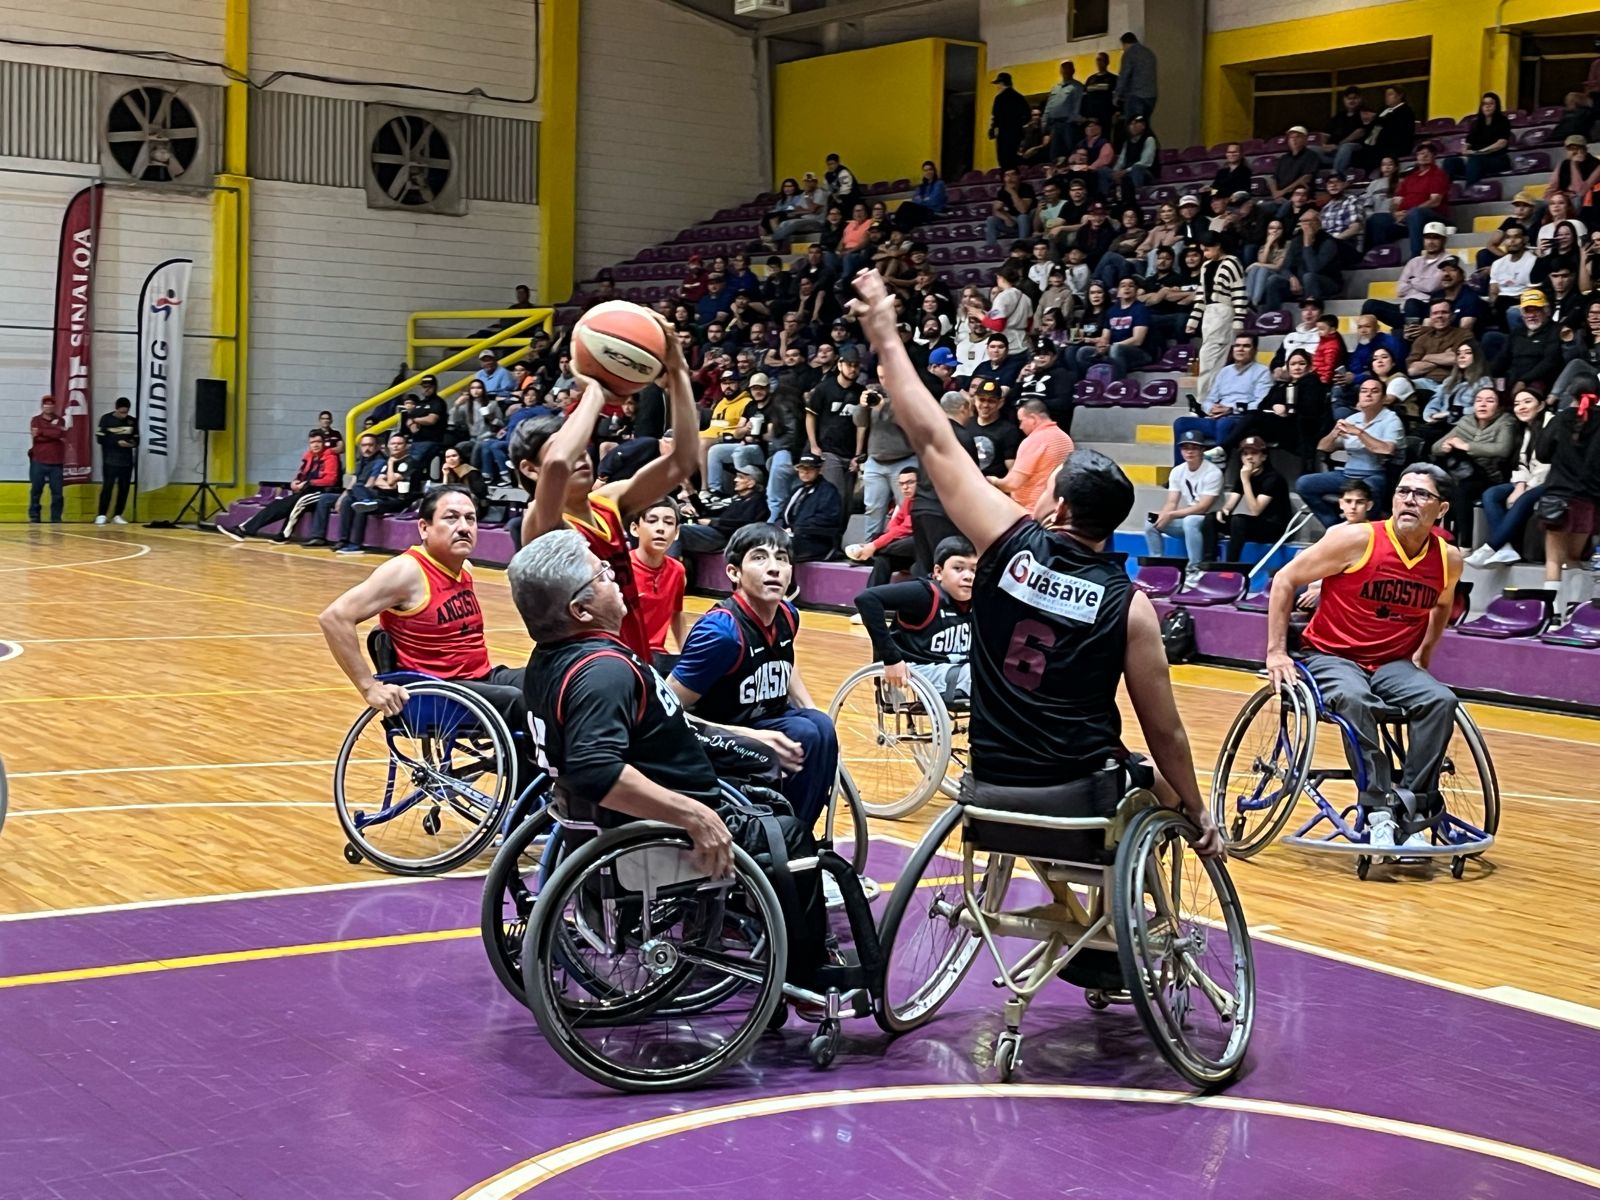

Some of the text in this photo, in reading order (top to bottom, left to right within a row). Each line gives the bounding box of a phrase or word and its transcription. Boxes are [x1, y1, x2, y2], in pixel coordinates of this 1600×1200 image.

[68, 228, 92, 416] DIF SINALOA
[148, 340, 168, 456] IMUDEG
[1008, 553, 1098, 607] Guasave
[931, 622, 972, 652] GUAS
[1003, 618, 1056, 691] 6
